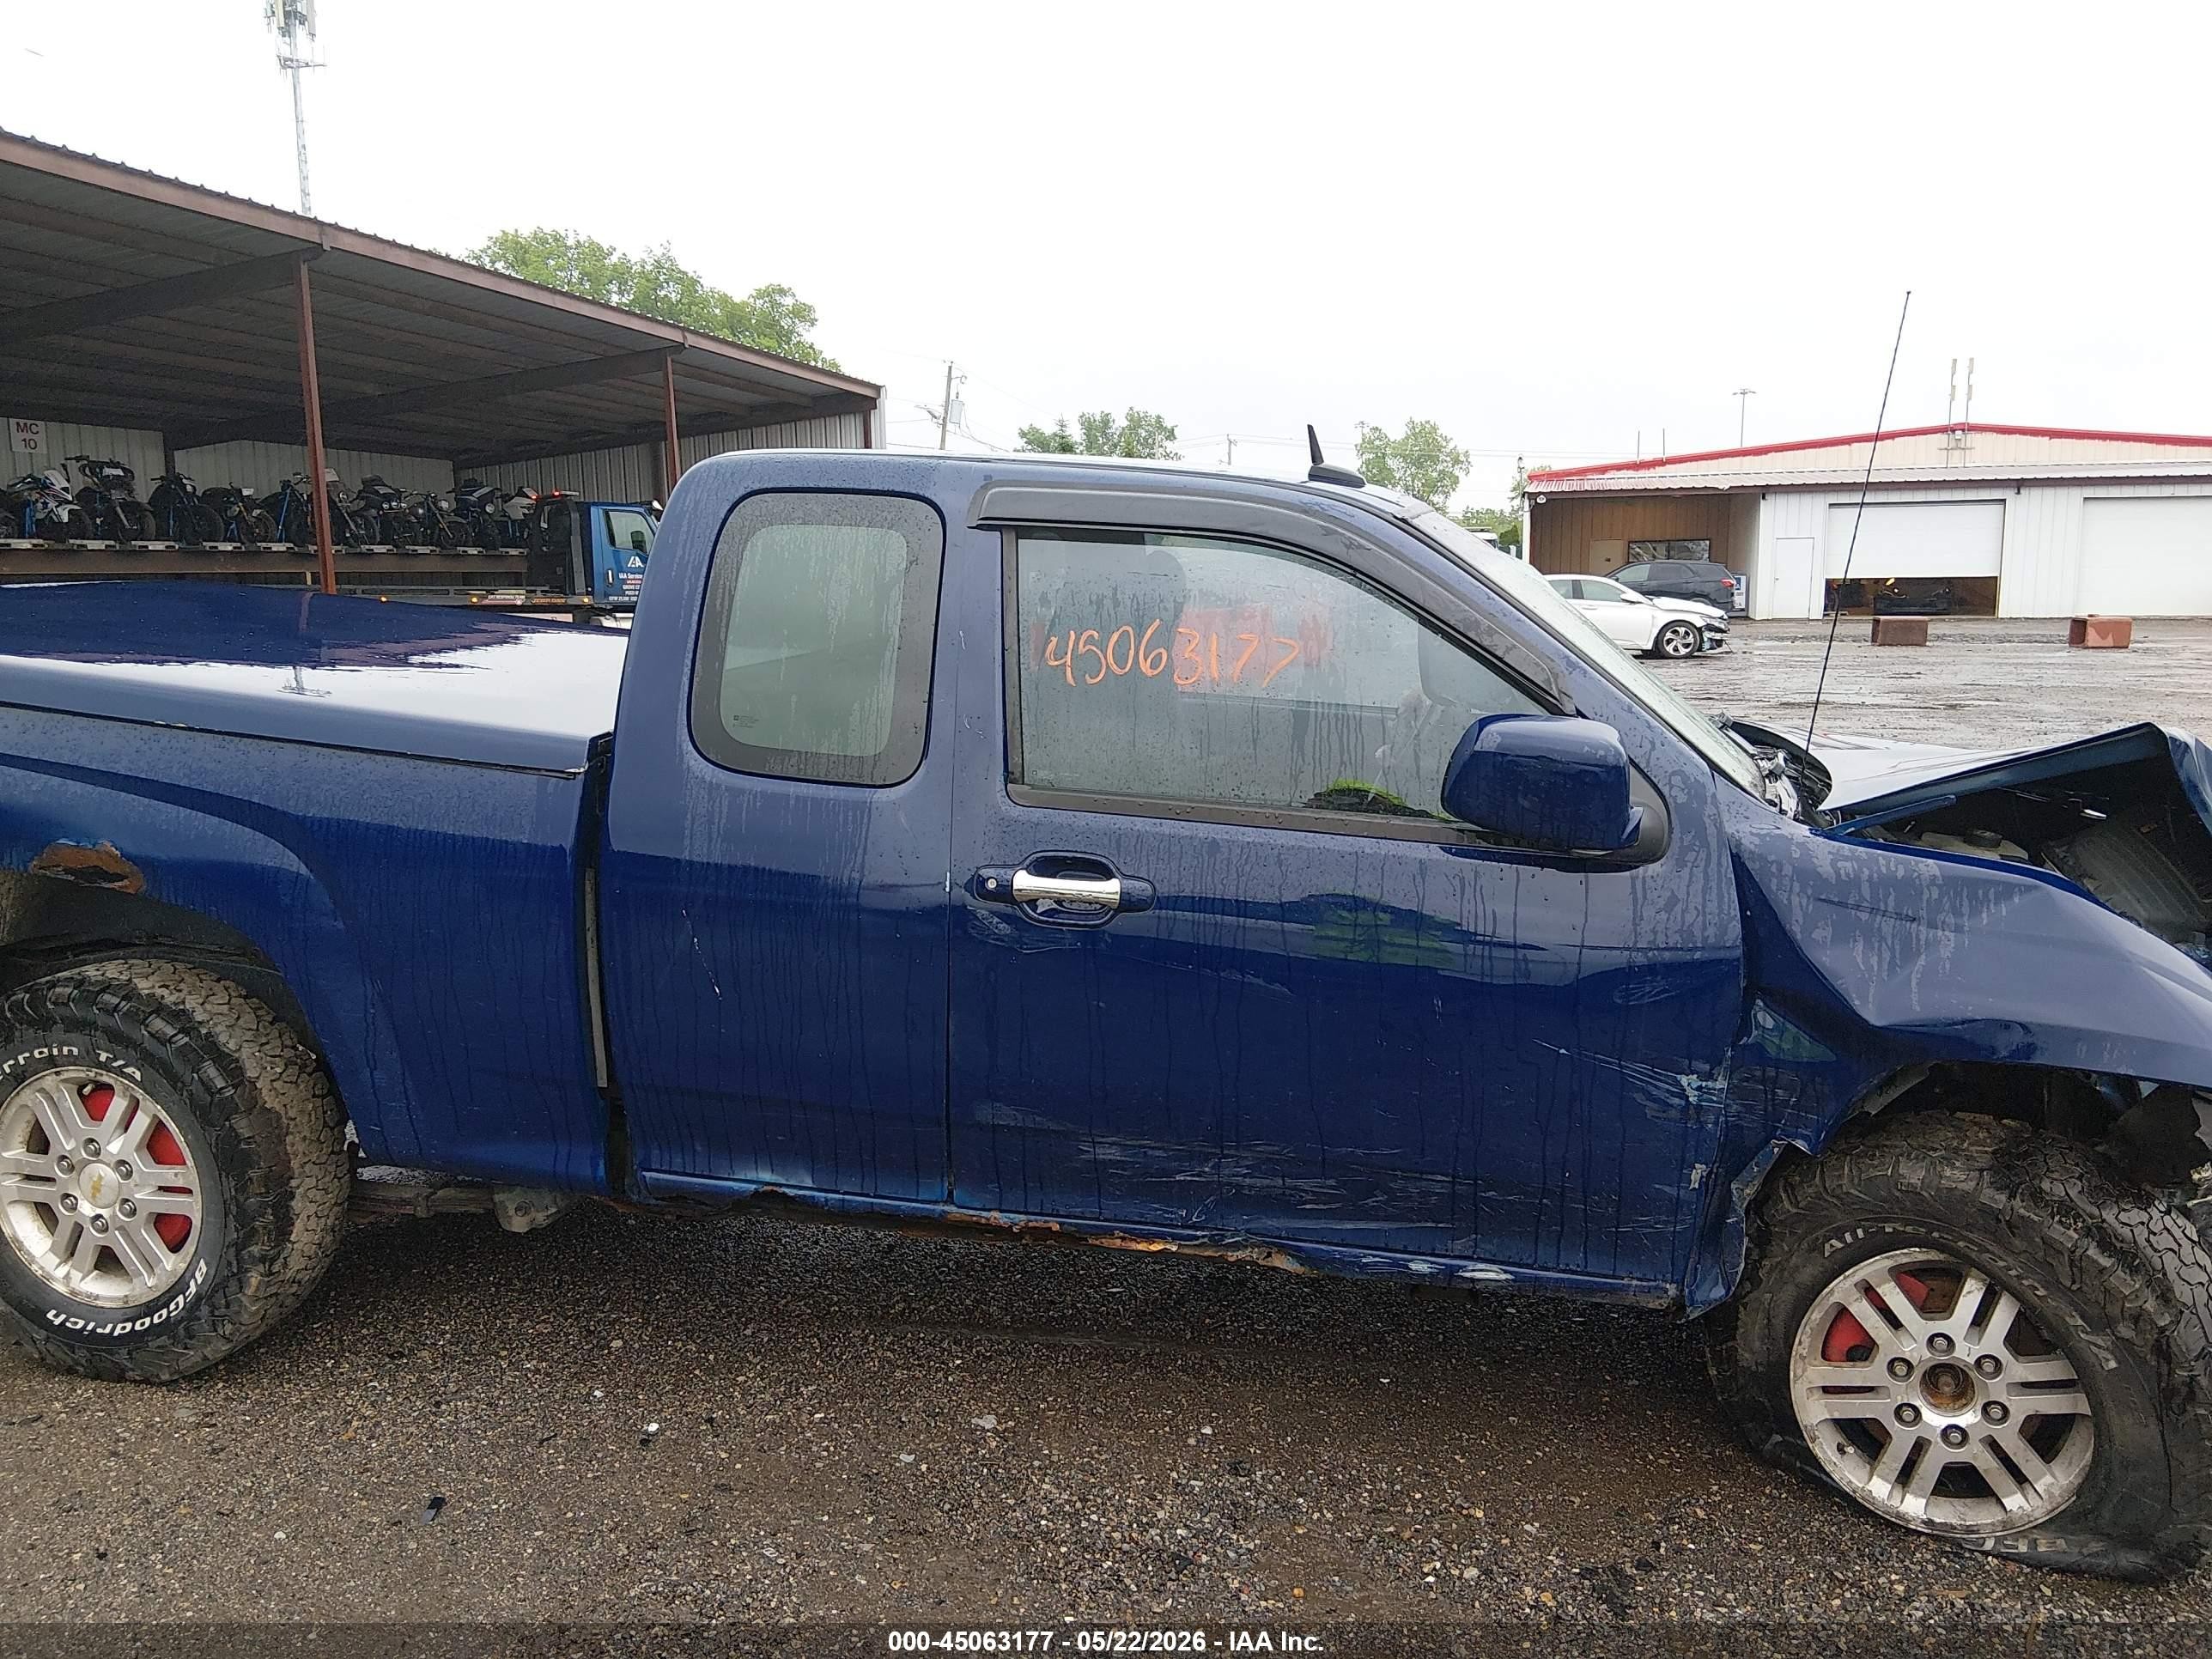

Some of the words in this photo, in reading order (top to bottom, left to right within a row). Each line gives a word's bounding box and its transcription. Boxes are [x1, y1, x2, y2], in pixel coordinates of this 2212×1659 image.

[15, 421, 40, 435] MC
[21, 438, 38, 450] 10
[1045, 618, 1300, 687] 45063177
[95, 1049, 142, 1082] T/A
[46, 1258, 208, 1337] BFGoodrich
